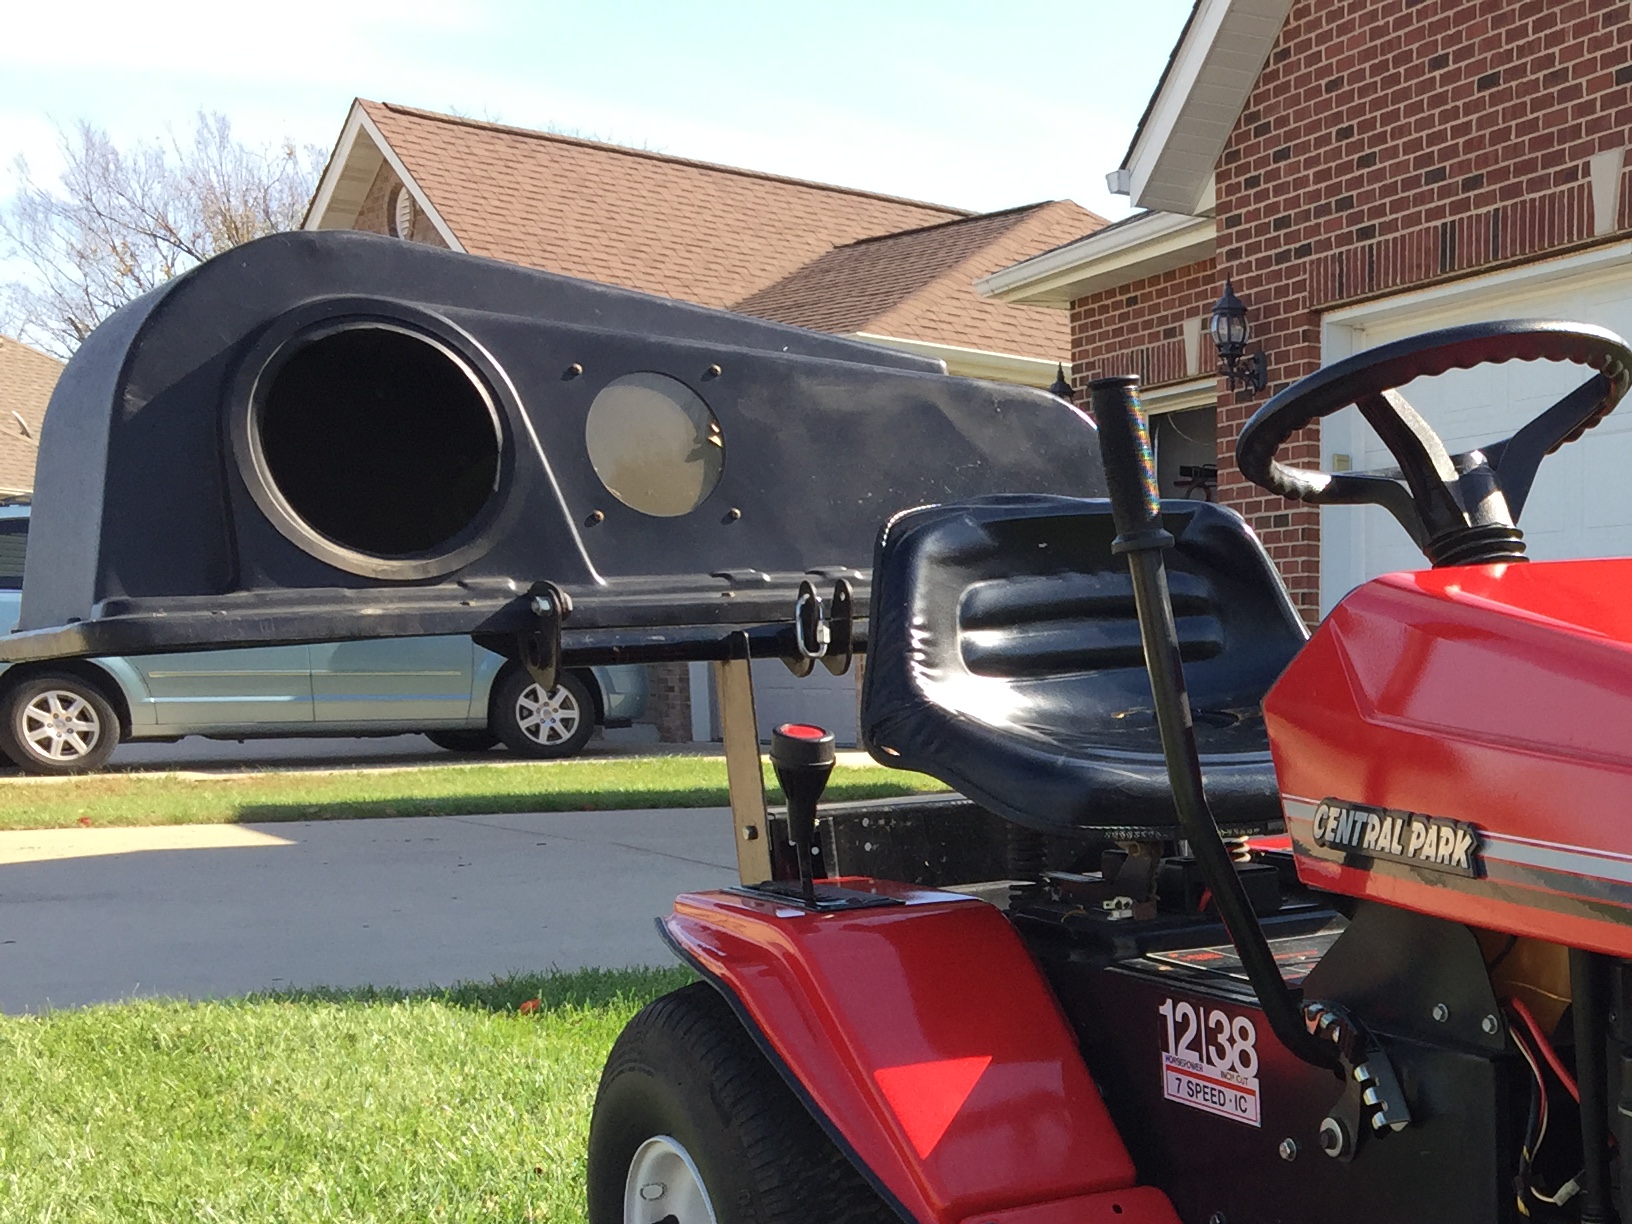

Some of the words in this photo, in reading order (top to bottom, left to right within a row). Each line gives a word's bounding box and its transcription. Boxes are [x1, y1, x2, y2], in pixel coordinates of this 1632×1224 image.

[1313, 804, 1404, 855] CENTRAL
[1408, 821, 1473, 869] PARK
[1175, 1077, 1182, 1094] 7
